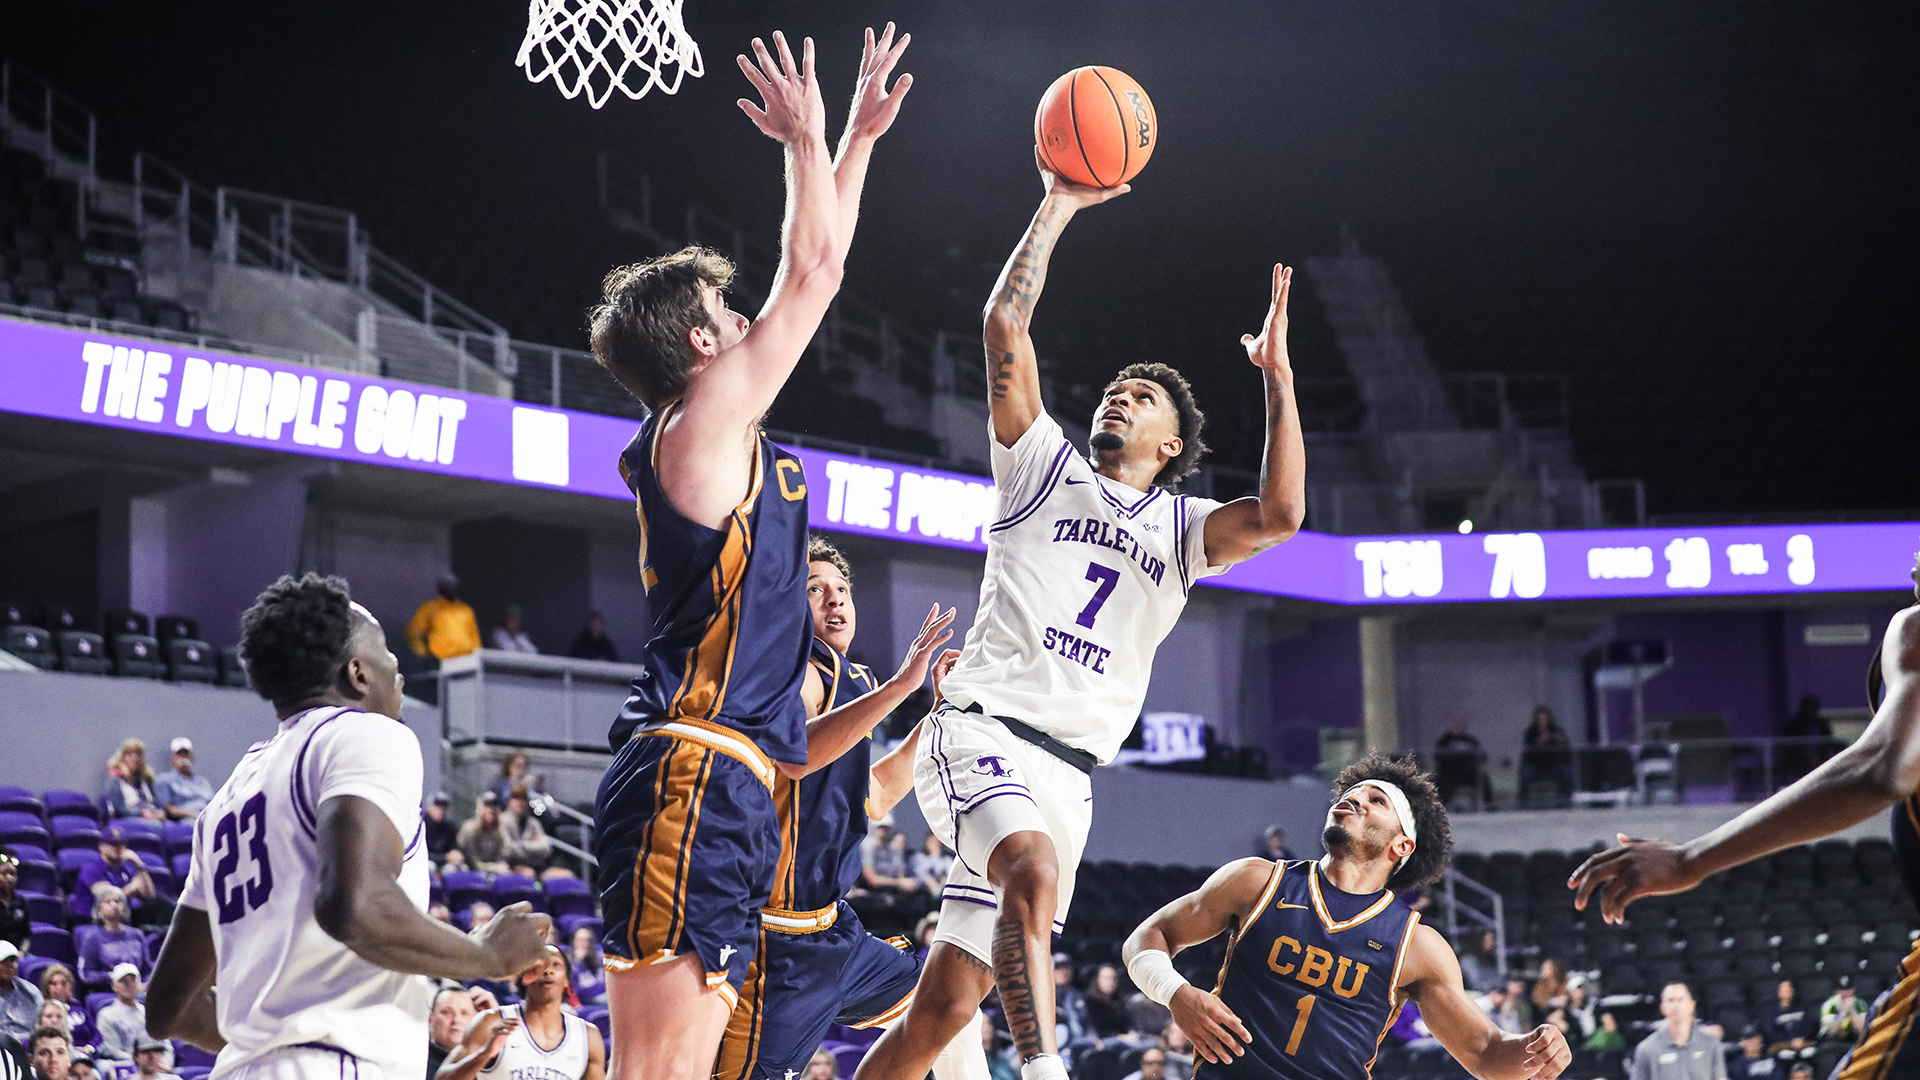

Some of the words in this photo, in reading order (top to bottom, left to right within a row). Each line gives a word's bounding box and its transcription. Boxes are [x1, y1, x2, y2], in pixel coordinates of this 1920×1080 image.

[1125, 91, 1150, 149] NCAA
[81, 341, 173, 424] THE
[175, 356, 351, 450] PURPLE
[354, 385, 468, 466] GOAT
[826, 459, 895, 530] THE
[1053, 518, 1166, 588] TARLETON
[1354, 540, 1444, 599] TSU
[1483, 532, 1547, 599] 70
[1075, 561, 1121, 630] 7
[1043, 626, 1111, 675] STATE
[213, 791, 273, 925] 23
[1267, 935, 1369, 998] CBU
[1285, 994, 1316, 1056] 1
